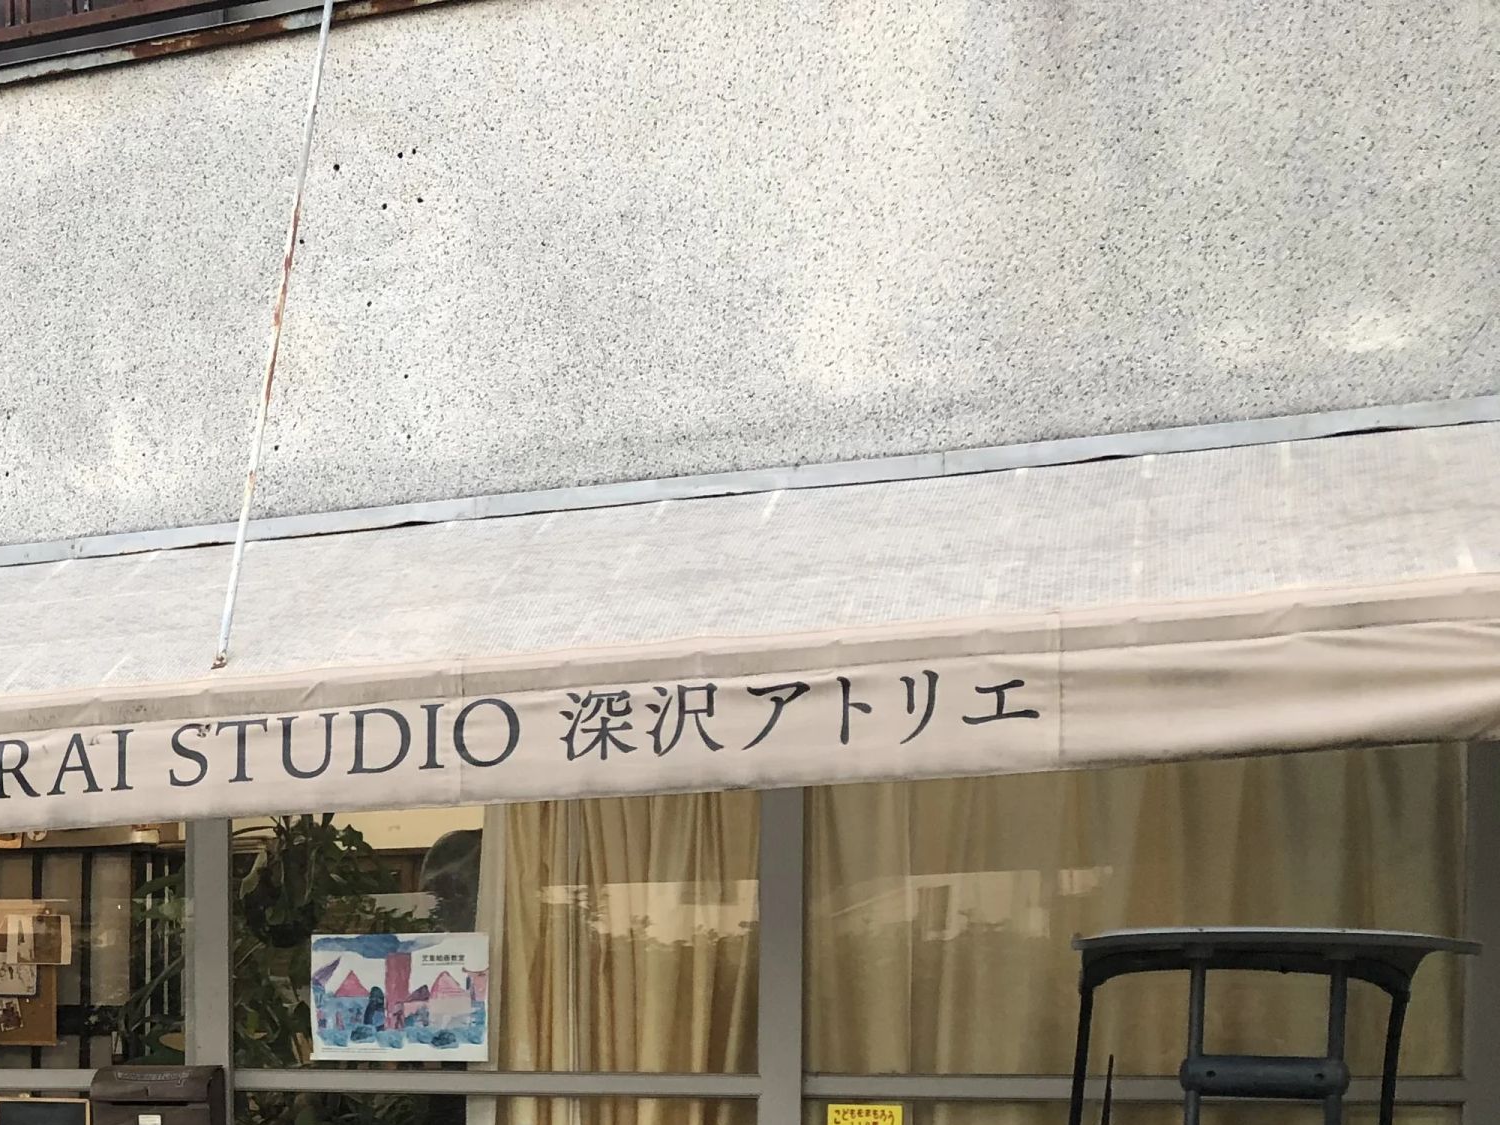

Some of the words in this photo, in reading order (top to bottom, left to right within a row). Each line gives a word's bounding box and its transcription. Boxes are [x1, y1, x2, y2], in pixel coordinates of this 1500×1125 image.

[169, 698, 521, 787] STUDIO
[558, 669, 1041, 761] 深沢アトリエ
